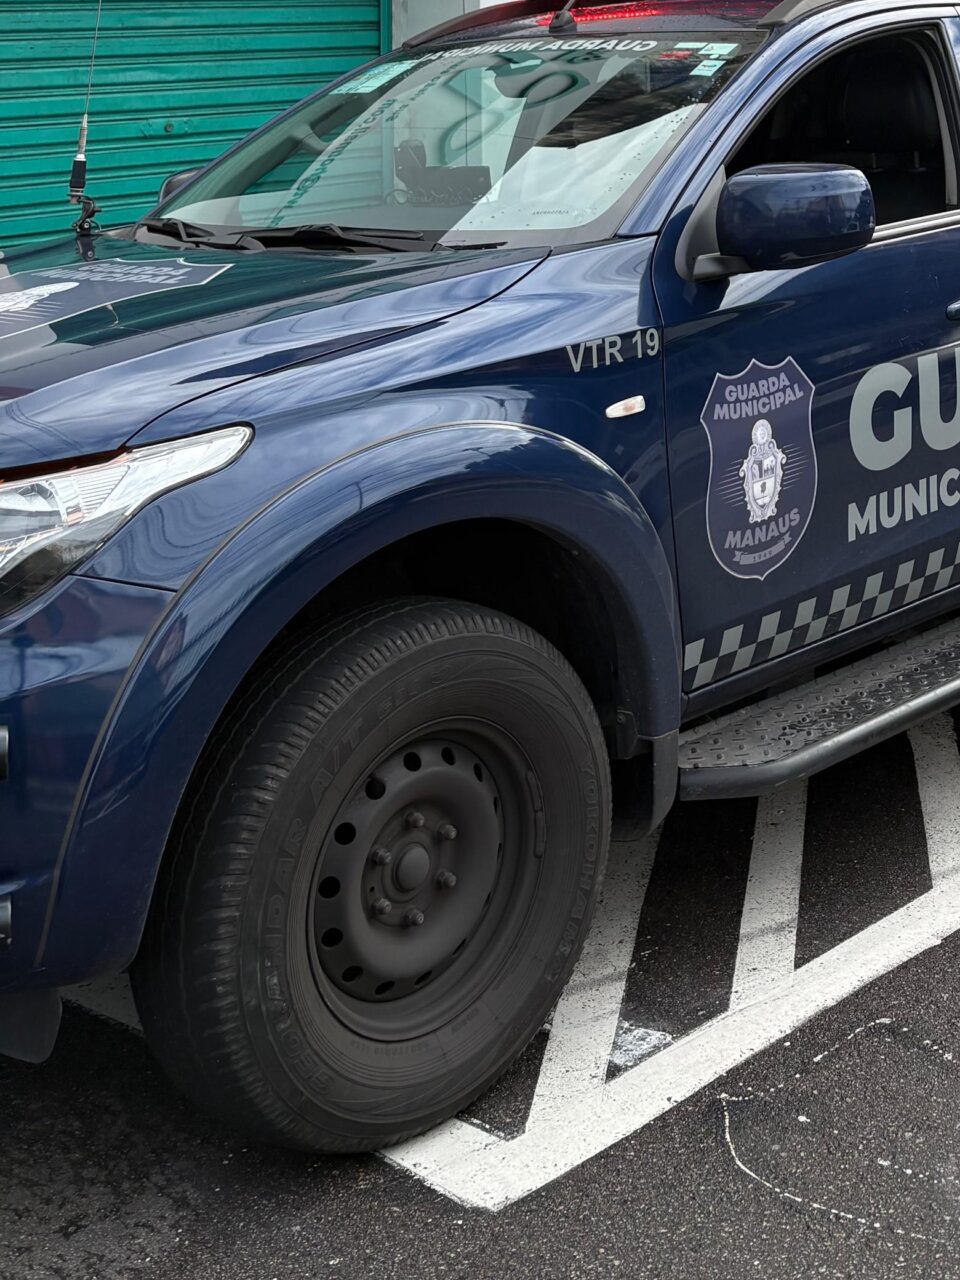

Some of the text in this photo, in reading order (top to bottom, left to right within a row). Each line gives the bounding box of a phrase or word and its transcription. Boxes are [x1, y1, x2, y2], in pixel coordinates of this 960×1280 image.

[566, 327, 660, 373] VTR 19
[713, 384, 804, 420] MUNICIPAL
[724, 372, 790, 402] GUARDA
[724, 508, 800, 549] MANAUS
